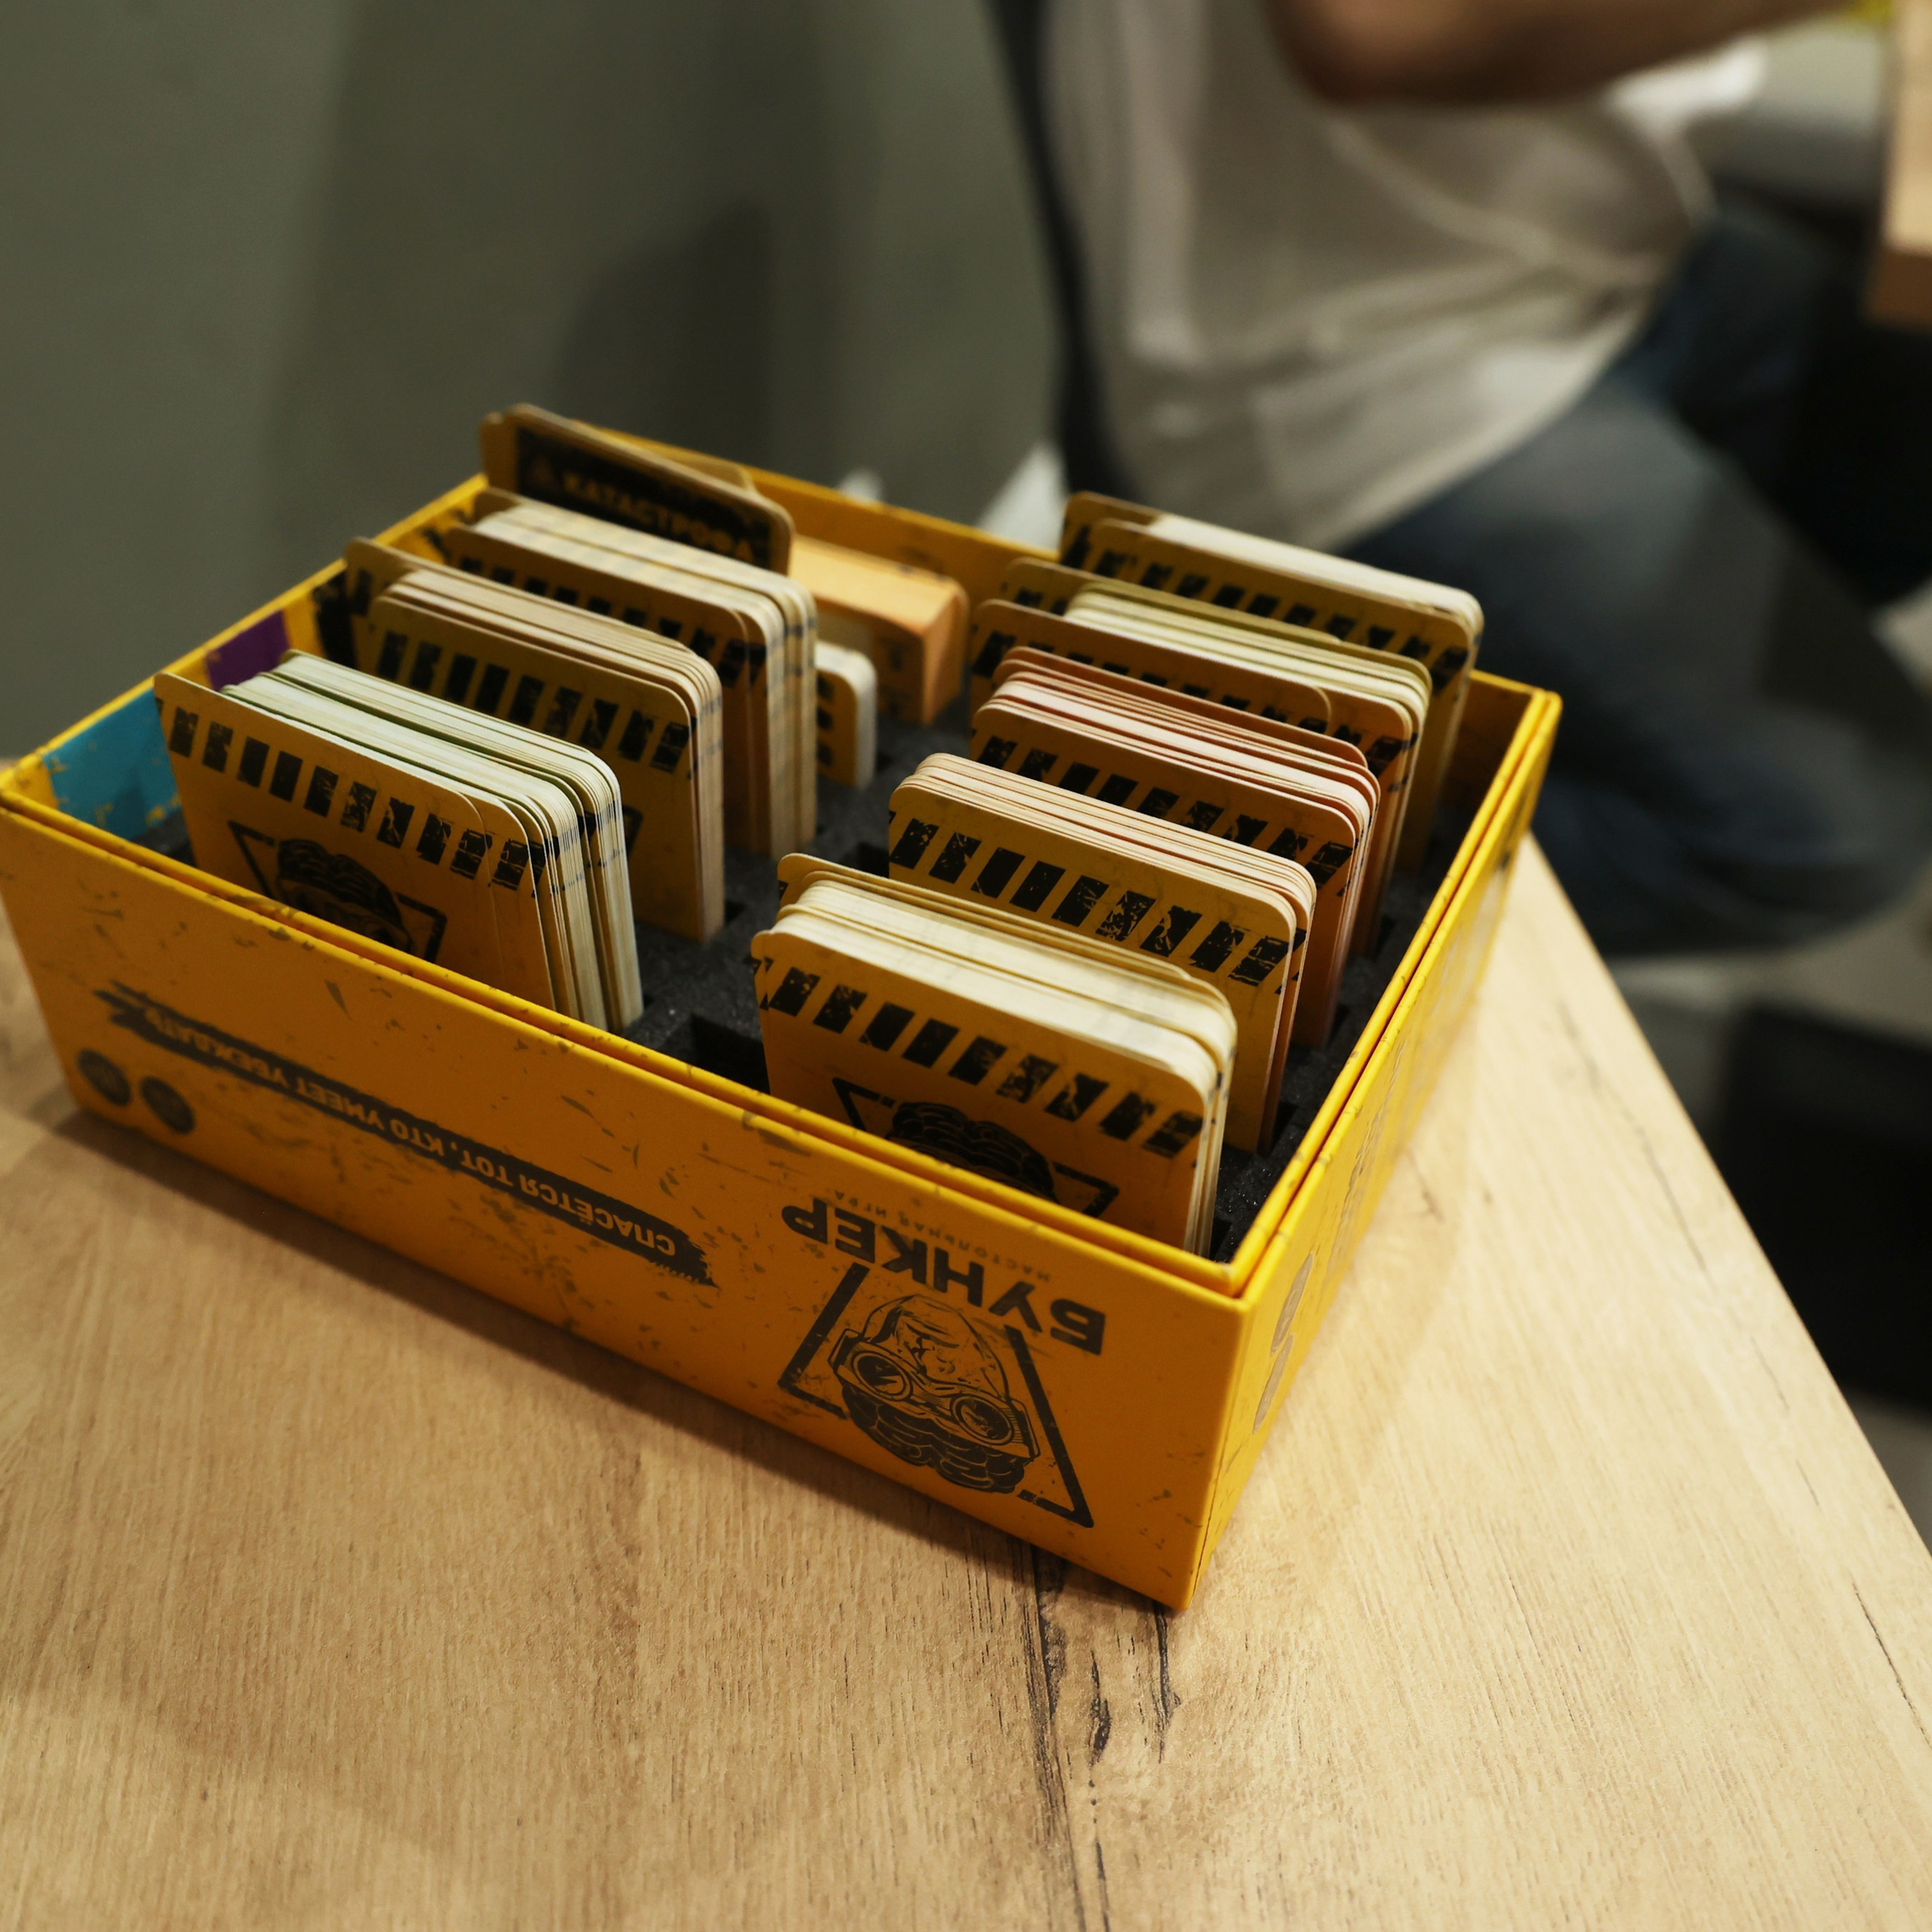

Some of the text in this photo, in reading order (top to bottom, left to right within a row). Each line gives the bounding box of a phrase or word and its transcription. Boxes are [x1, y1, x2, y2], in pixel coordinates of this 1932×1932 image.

[143, 1006, 676, 1257] СПАСЁТСЯ ТОТ, КТО УМЕЕТ УБЕЖДАТЬ
[781, 1197, 1106, 1356] БУНКЕР
[833, 1189, 1051, 1283] НАСТОЛЬНАЯ ИГРА
